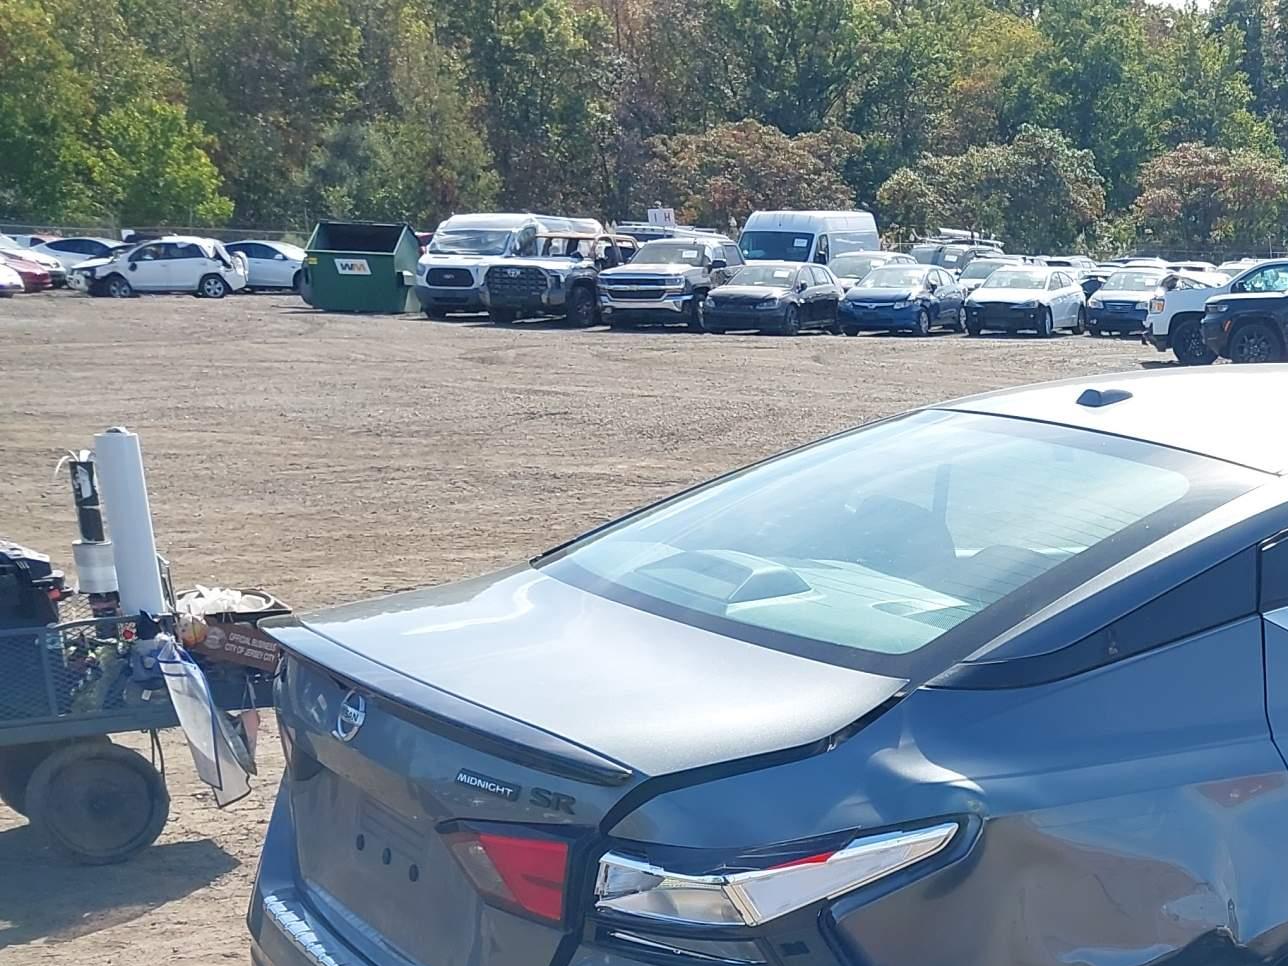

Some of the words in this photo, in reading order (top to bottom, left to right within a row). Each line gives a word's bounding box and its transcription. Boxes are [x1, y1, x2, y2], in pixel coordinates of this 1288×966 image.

[340, 262, 367, 273] WM
[224, 642, 236, 653] CITY
[244, 648, 263, 659] JERSEY
[263, 652, 275, 663] CITY
[457, 772, 514, 798] MIDNIGHT
[528, 786, 577, 816] SR
